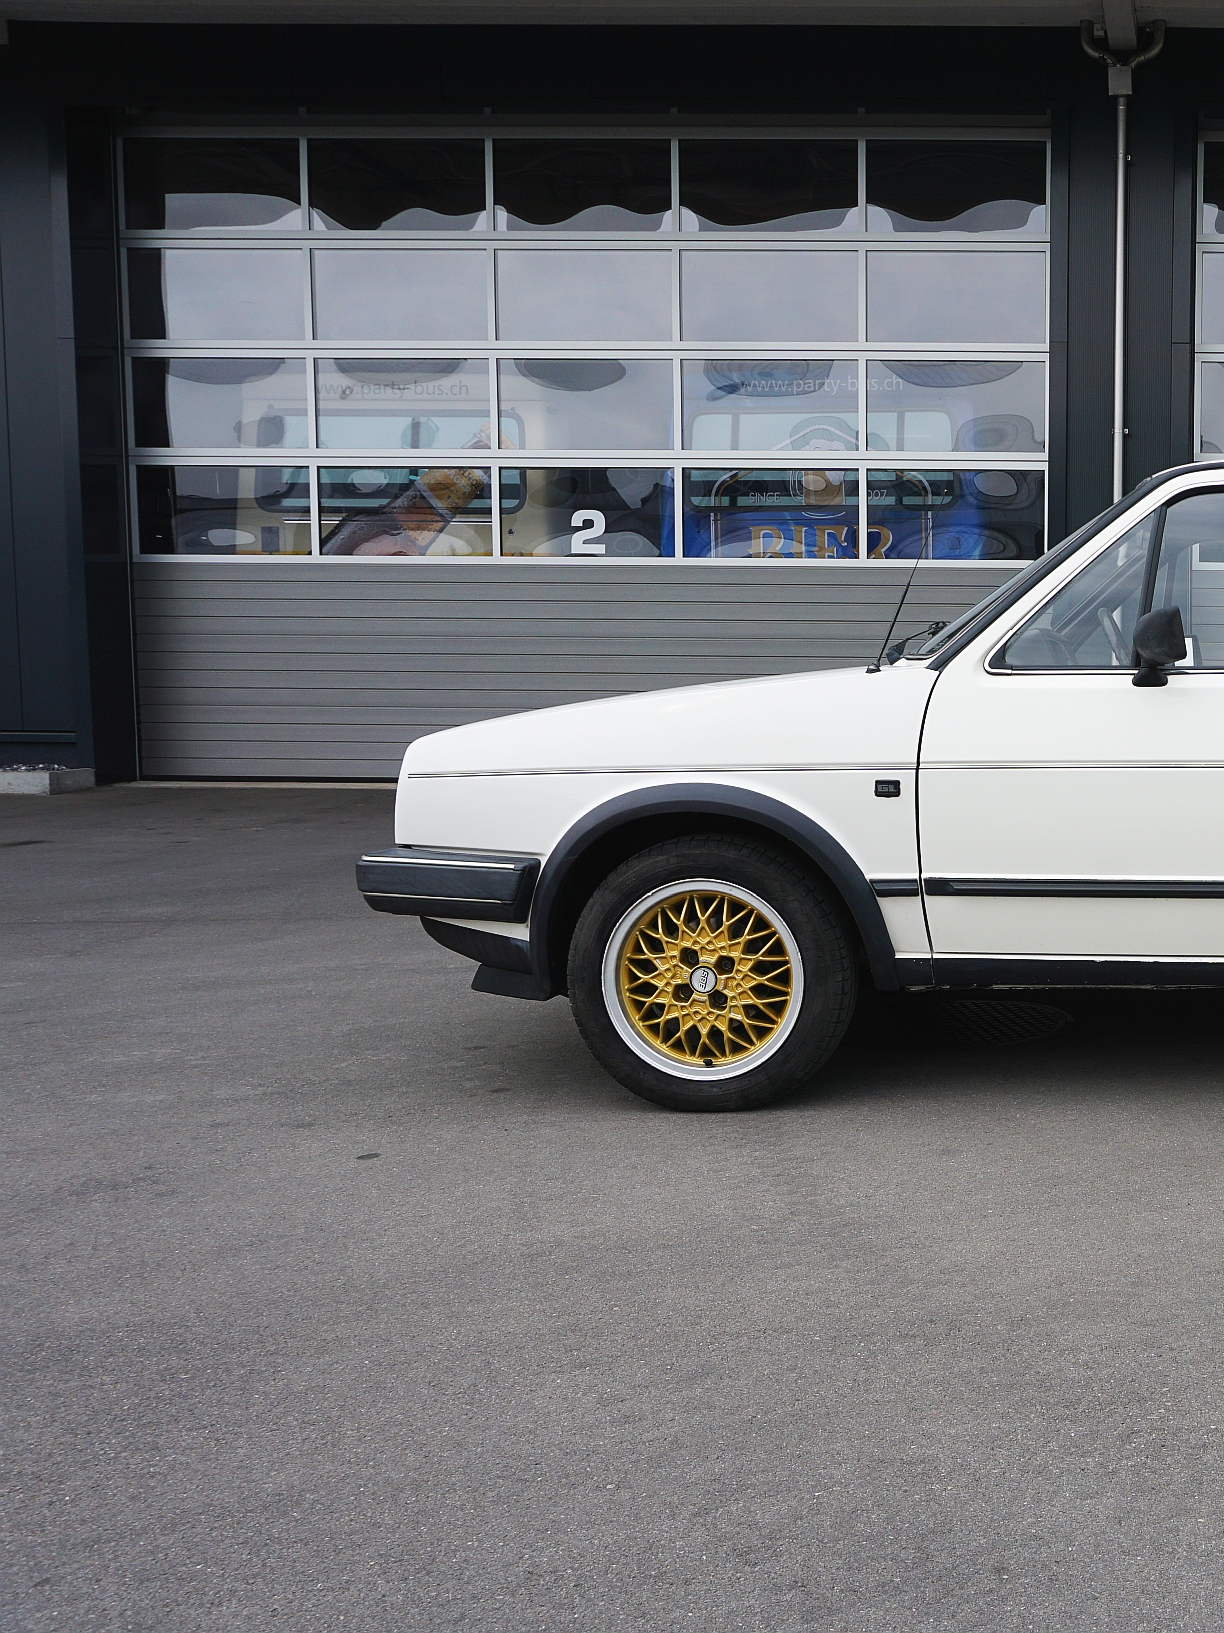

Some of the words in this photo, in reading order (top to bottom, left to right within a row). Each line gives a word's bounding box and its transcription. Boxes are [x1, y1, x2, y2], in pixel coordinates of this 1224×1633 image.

[738, 375, 903, 394] www.party-bs.ch
[444, 468, 471, 493] AGER
[749, 492, 781, 503] SINCE
[867, 489, 887, 500] 007
[571, 510, 606, 554] 2
